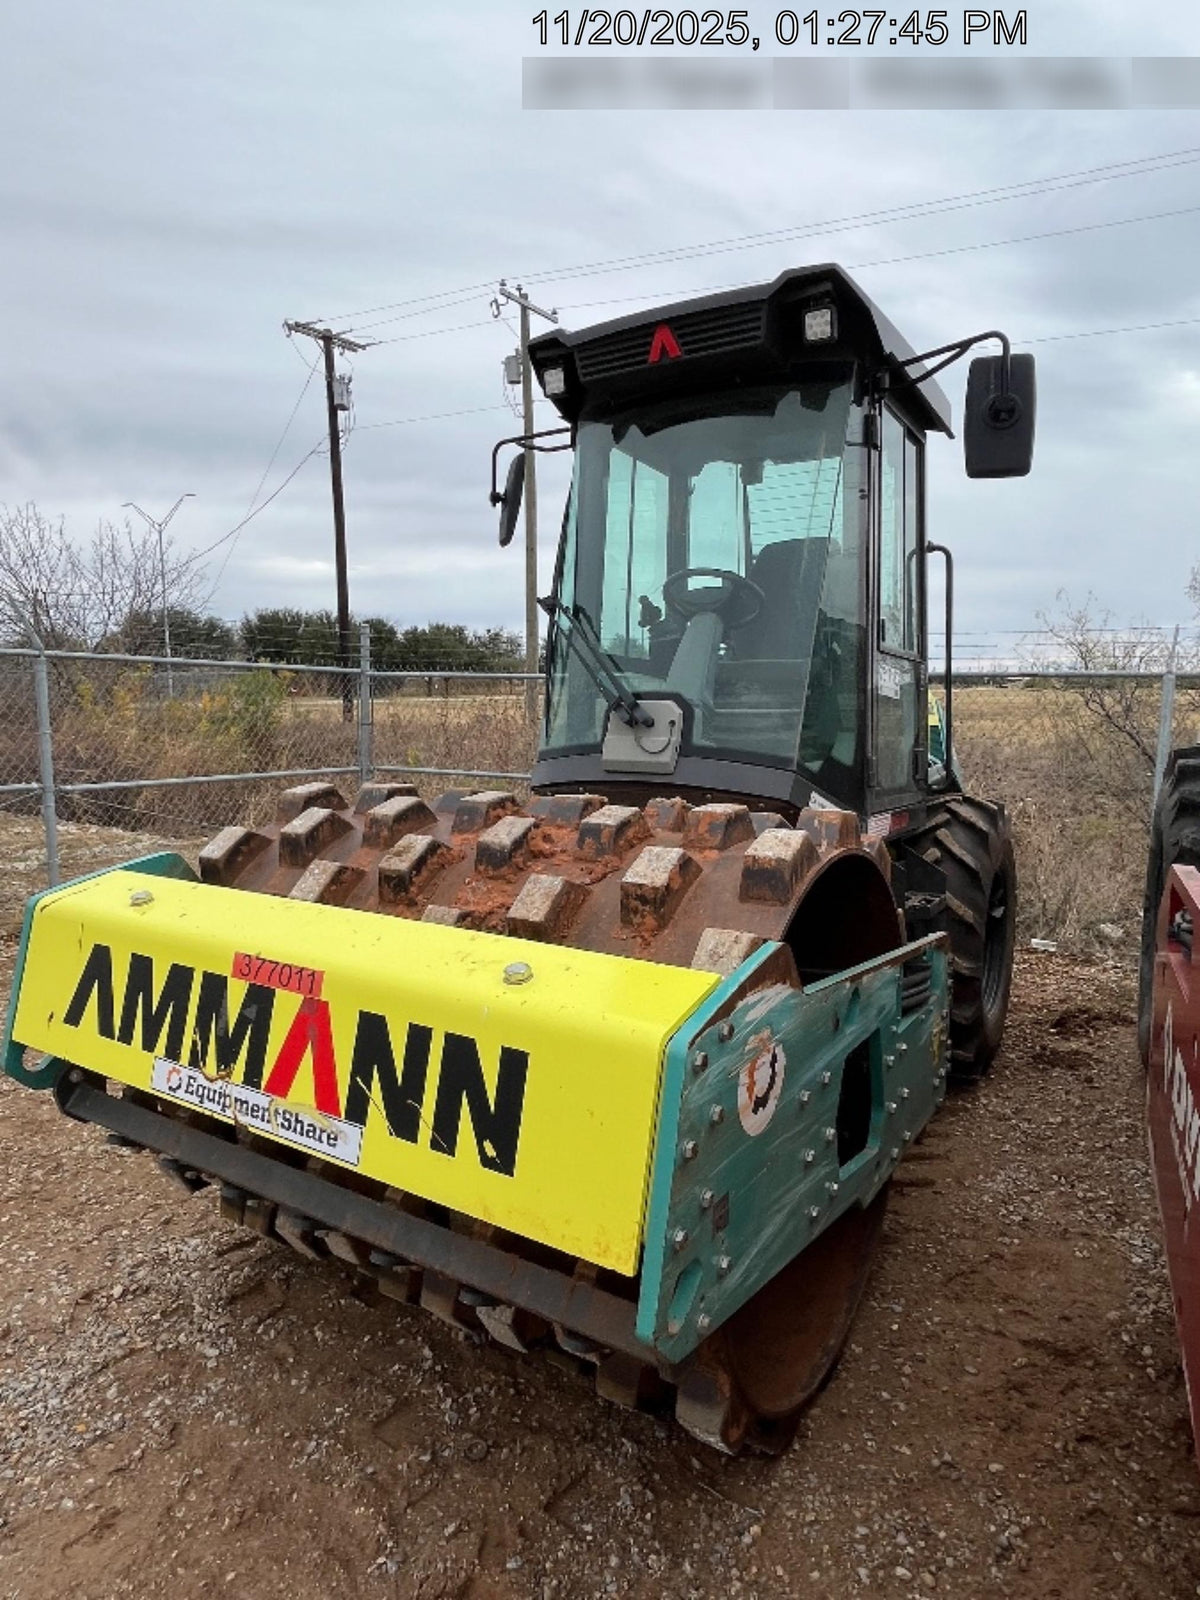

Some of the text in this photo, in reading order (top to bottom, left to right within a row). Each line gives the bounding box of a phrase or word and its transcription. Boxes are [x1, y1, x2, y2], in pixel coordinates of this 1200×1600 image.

[239, 953, 316, 995] 377011
[63, 943, 530, 1178] AMMANN
[184, 1075, 339, 1149] EquipmentShare
